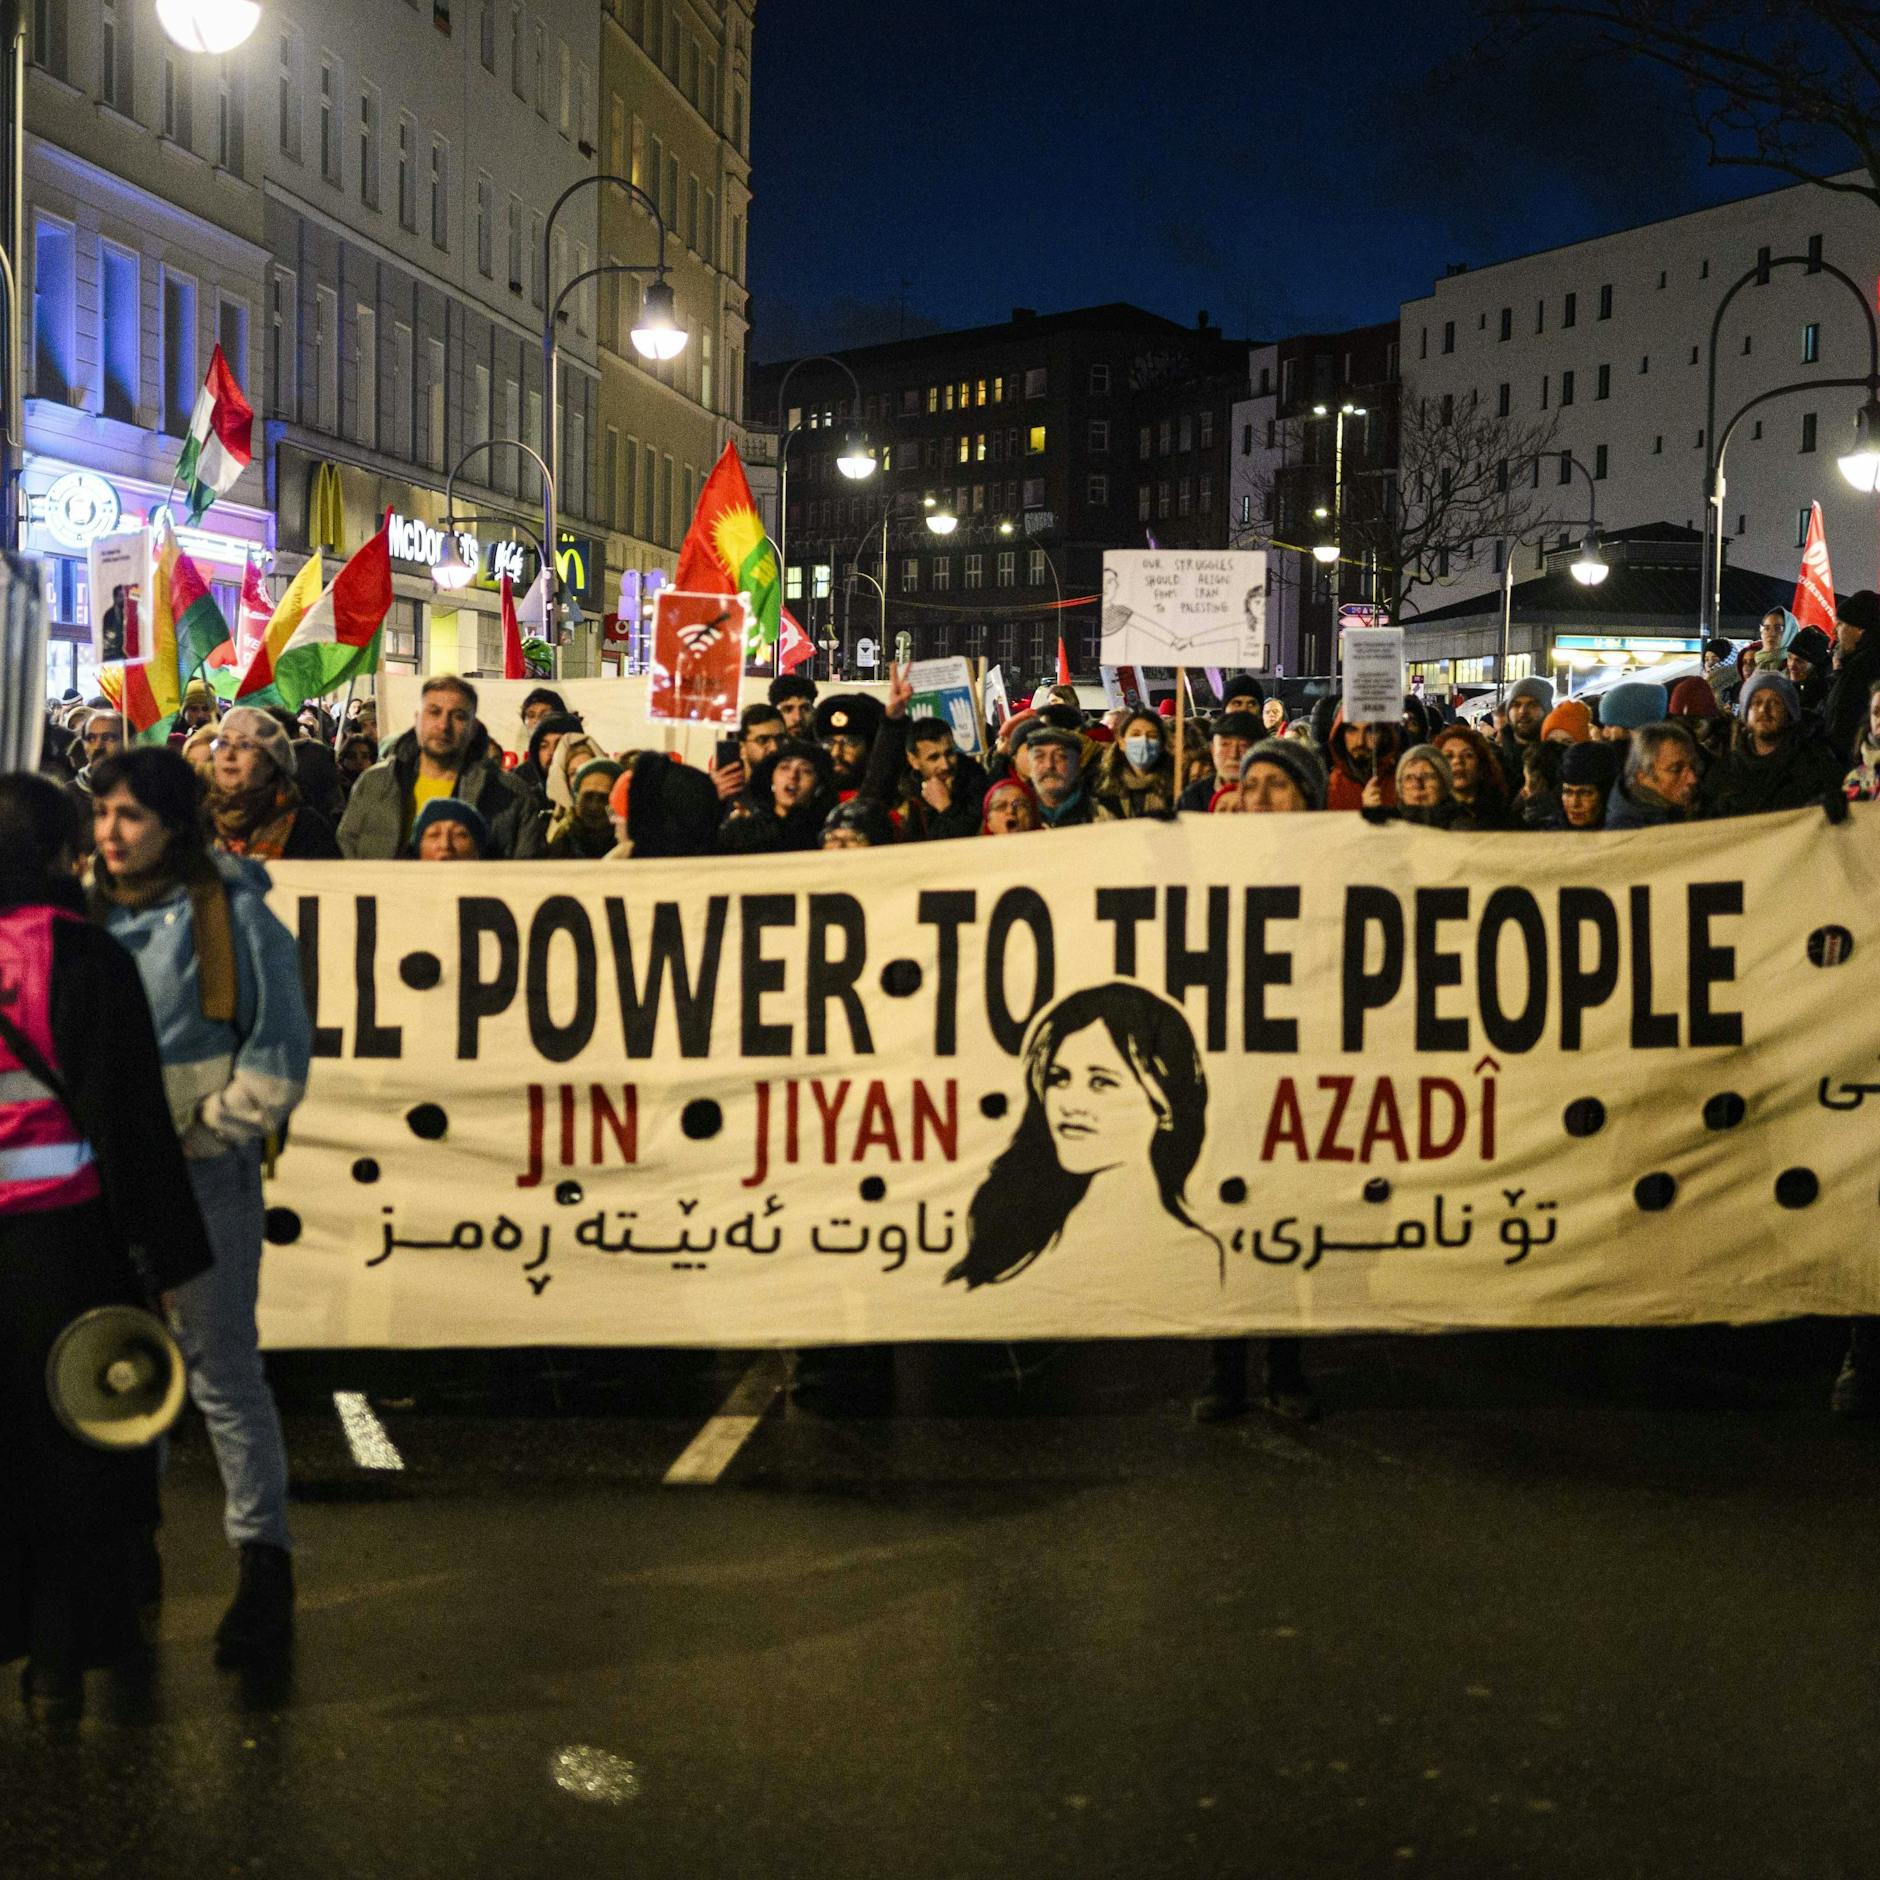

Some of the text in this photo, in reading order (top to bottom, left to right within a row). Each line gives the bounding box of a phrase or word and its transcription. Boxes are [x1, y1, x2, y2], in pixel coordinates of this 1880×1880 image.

[1145, 574, 1179, 587] SHOULD
[1174, 559, 1234, 571] STRUGGLES
[1195, 588, 1219, 599] IRAN
[297, 881, 1745, 1063] LL POWER TO THE PEOPLE
[516, 1055, 1500, 1189] JIN JIYAN AZADÎ
[811, 1200, 955, 1273] ناوت
